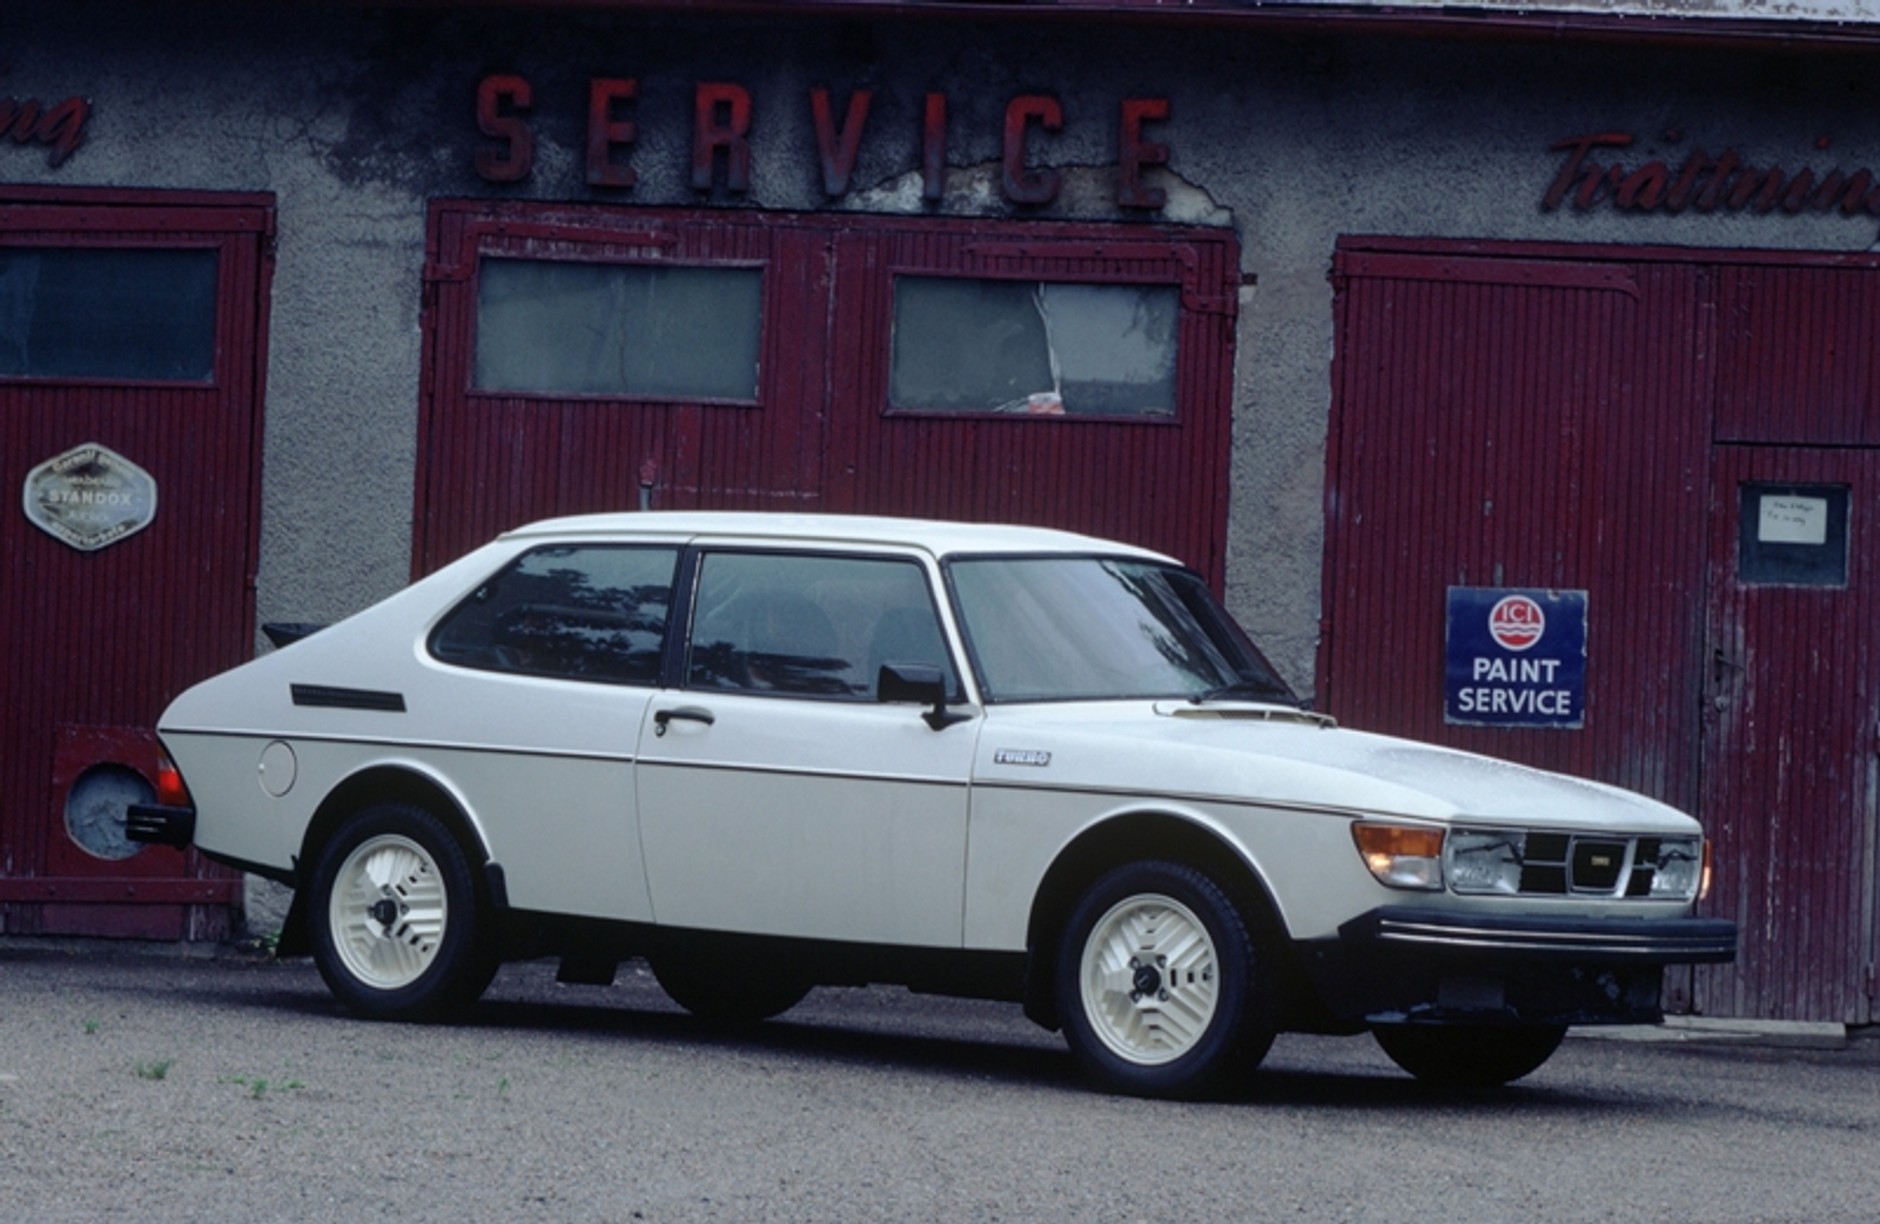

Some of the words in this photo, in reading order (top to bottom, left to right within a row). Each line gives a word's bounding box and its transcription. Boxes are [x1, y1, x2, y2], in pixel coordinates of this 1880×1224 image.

[474, 74, 1169, 208] SERVICE
[49, 489, 132, 506] STANDOX
[1501, 604, 1533, 622] ICI
[1473, 657, 1561, 683] PAINT
[1458, 687, 1571, 715] SERVICE
